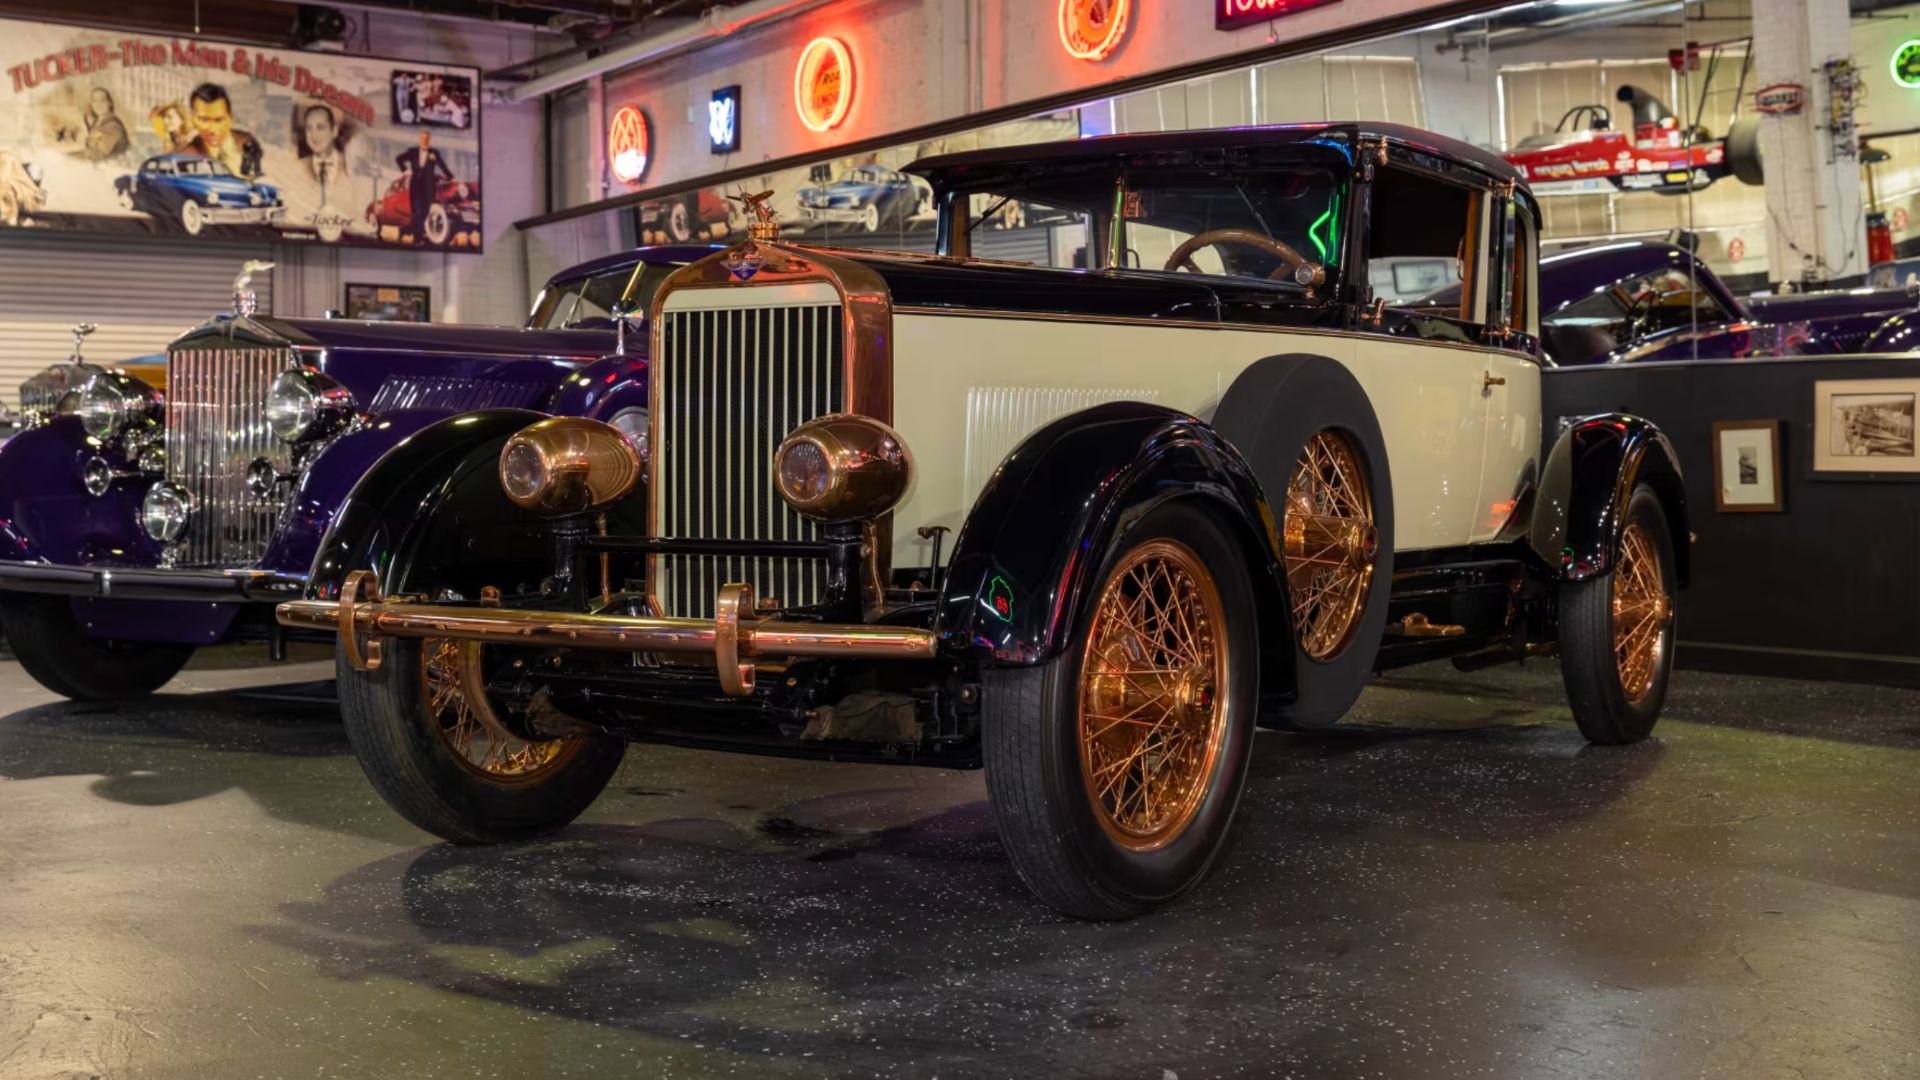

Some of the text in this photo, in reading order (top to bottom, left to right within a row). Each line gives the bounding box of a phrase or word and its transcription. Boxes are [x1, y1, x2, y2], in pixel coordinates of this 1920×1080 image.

[172, 39, 227, 70] Man
[232, 47, 251, 75] &
[256, 53, 291, 86] his
[294, 65, 375, 126] Dream
